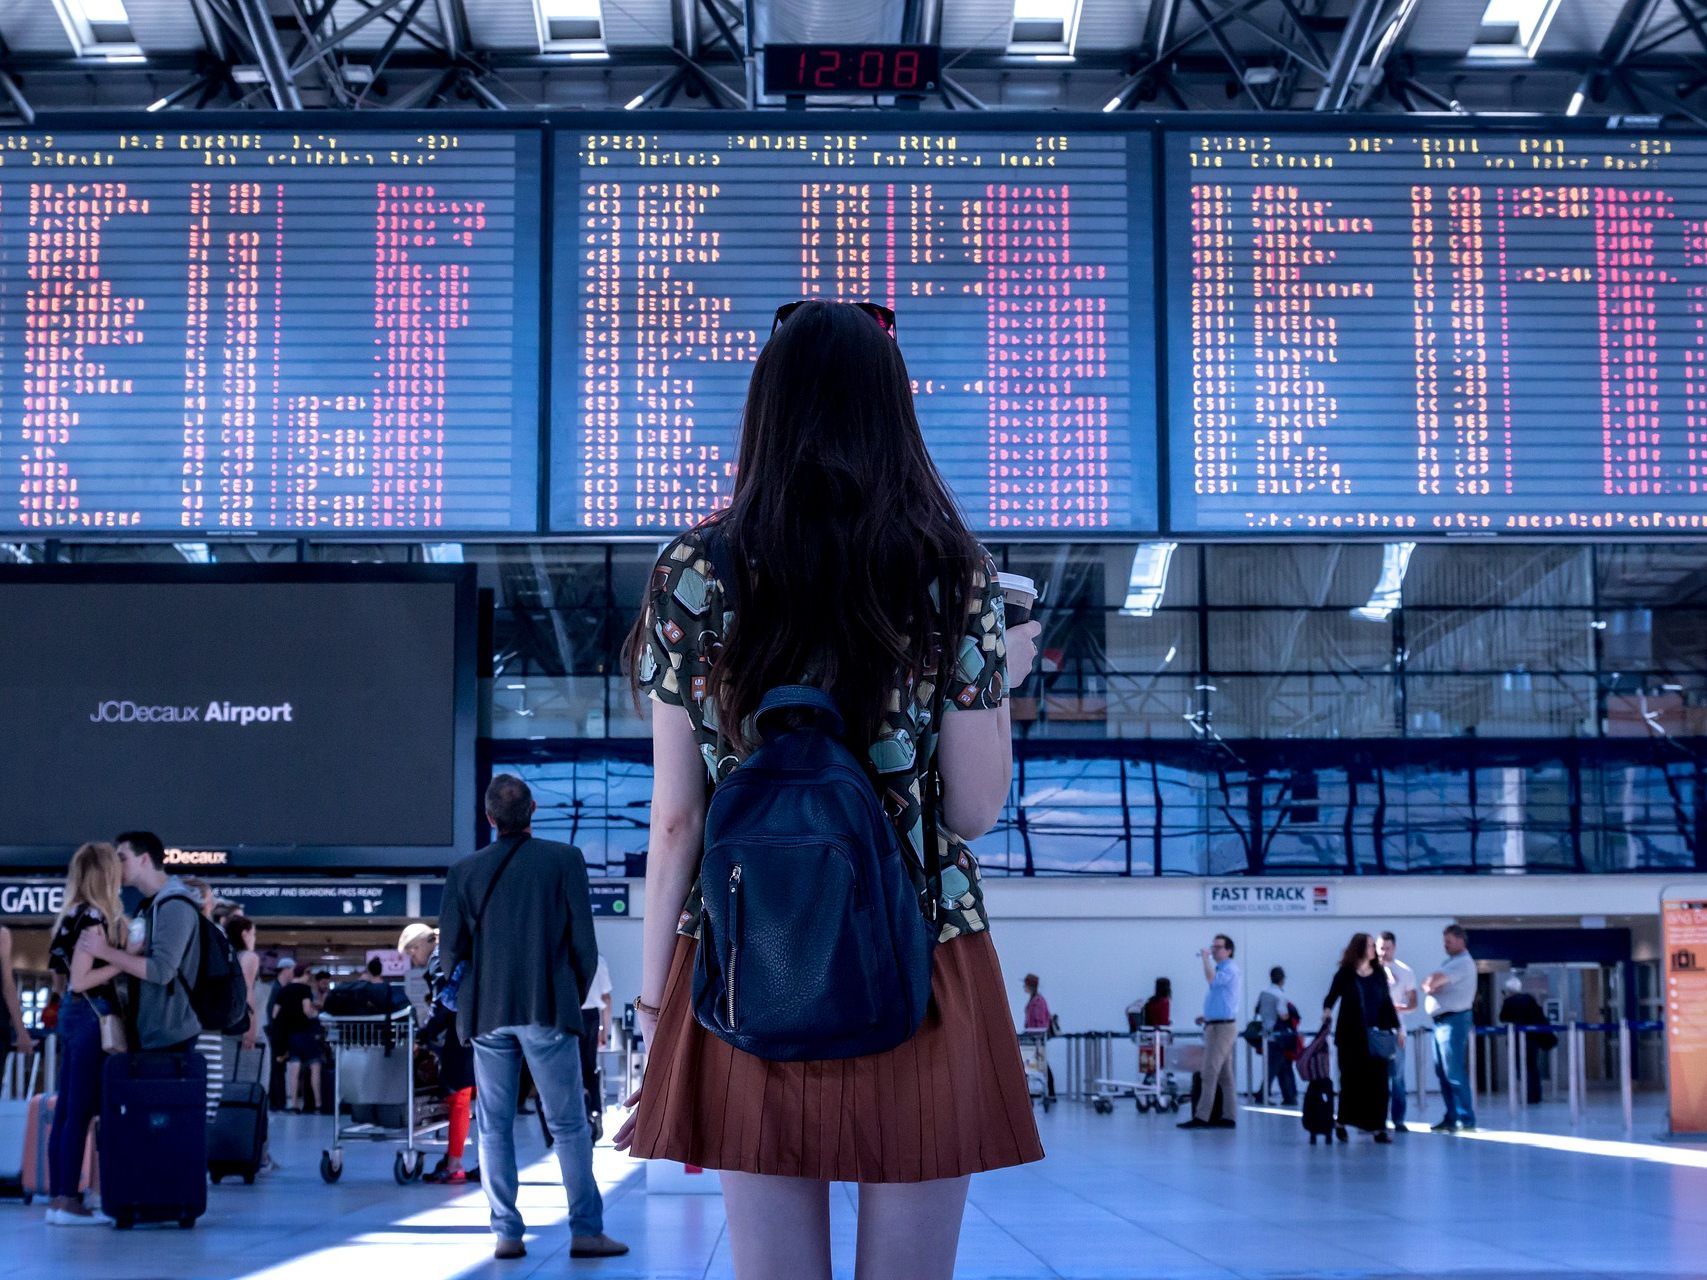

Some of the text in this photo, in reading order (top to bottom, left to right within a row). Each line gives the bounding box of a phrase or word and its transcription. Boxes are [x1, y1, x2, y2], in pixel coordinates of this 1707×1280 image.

[797, 51, 920, 87] 12:08
[89, 701, 293, 726] JCDecaux Airport
[221, 888, 242, 897] YOUR
[242, 888, 280, 897] PASSPORT
[281, 888, 297, 897] AND
[298, 888, 336, 897] BOARDING
[337, 888, 356, 897] PASS
[357, 888, 384, 897] READY
[1212, 887, 1249, 900] FAST
[1255, 887, 1305, 900] TRACK
